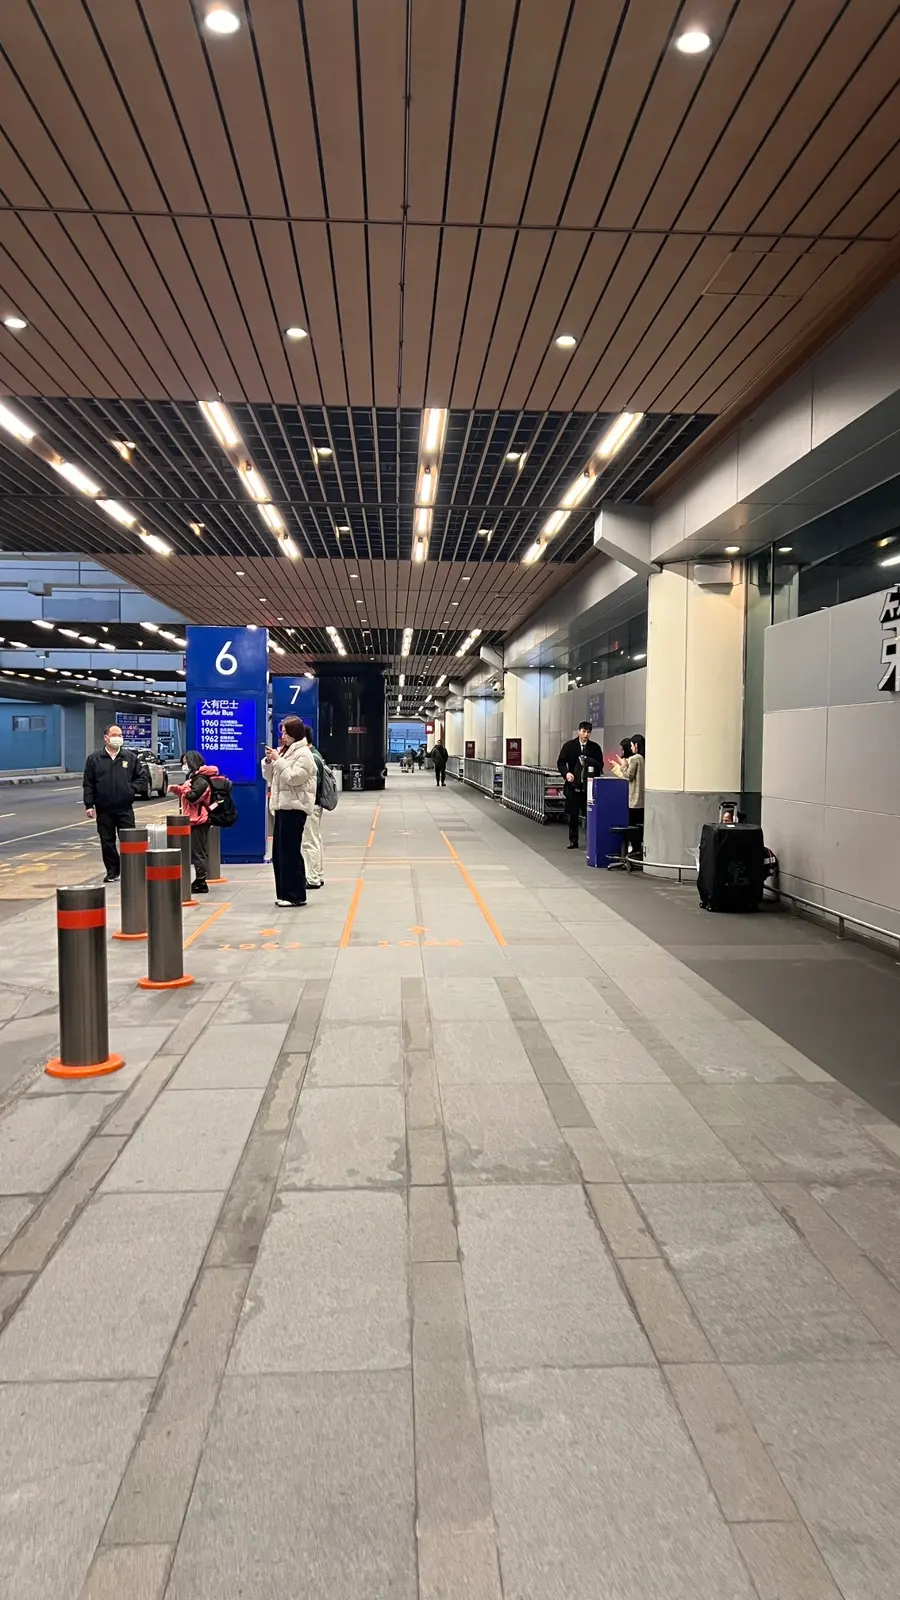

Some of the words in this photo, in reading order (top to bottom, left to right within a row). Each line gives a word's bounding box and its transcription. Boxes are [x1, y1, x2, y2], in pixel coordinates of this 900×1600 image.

[215, 640, 238, 675] 6
[289, 685, 301, 705] 7
[201, 699, 239, 709] 大有巴士
[201, 719, 219, 727] 1960
[201, 727, 218, 735] 1961
[201, 735, 219, 743] 1962
[201, 743, 219, 751] 1968
